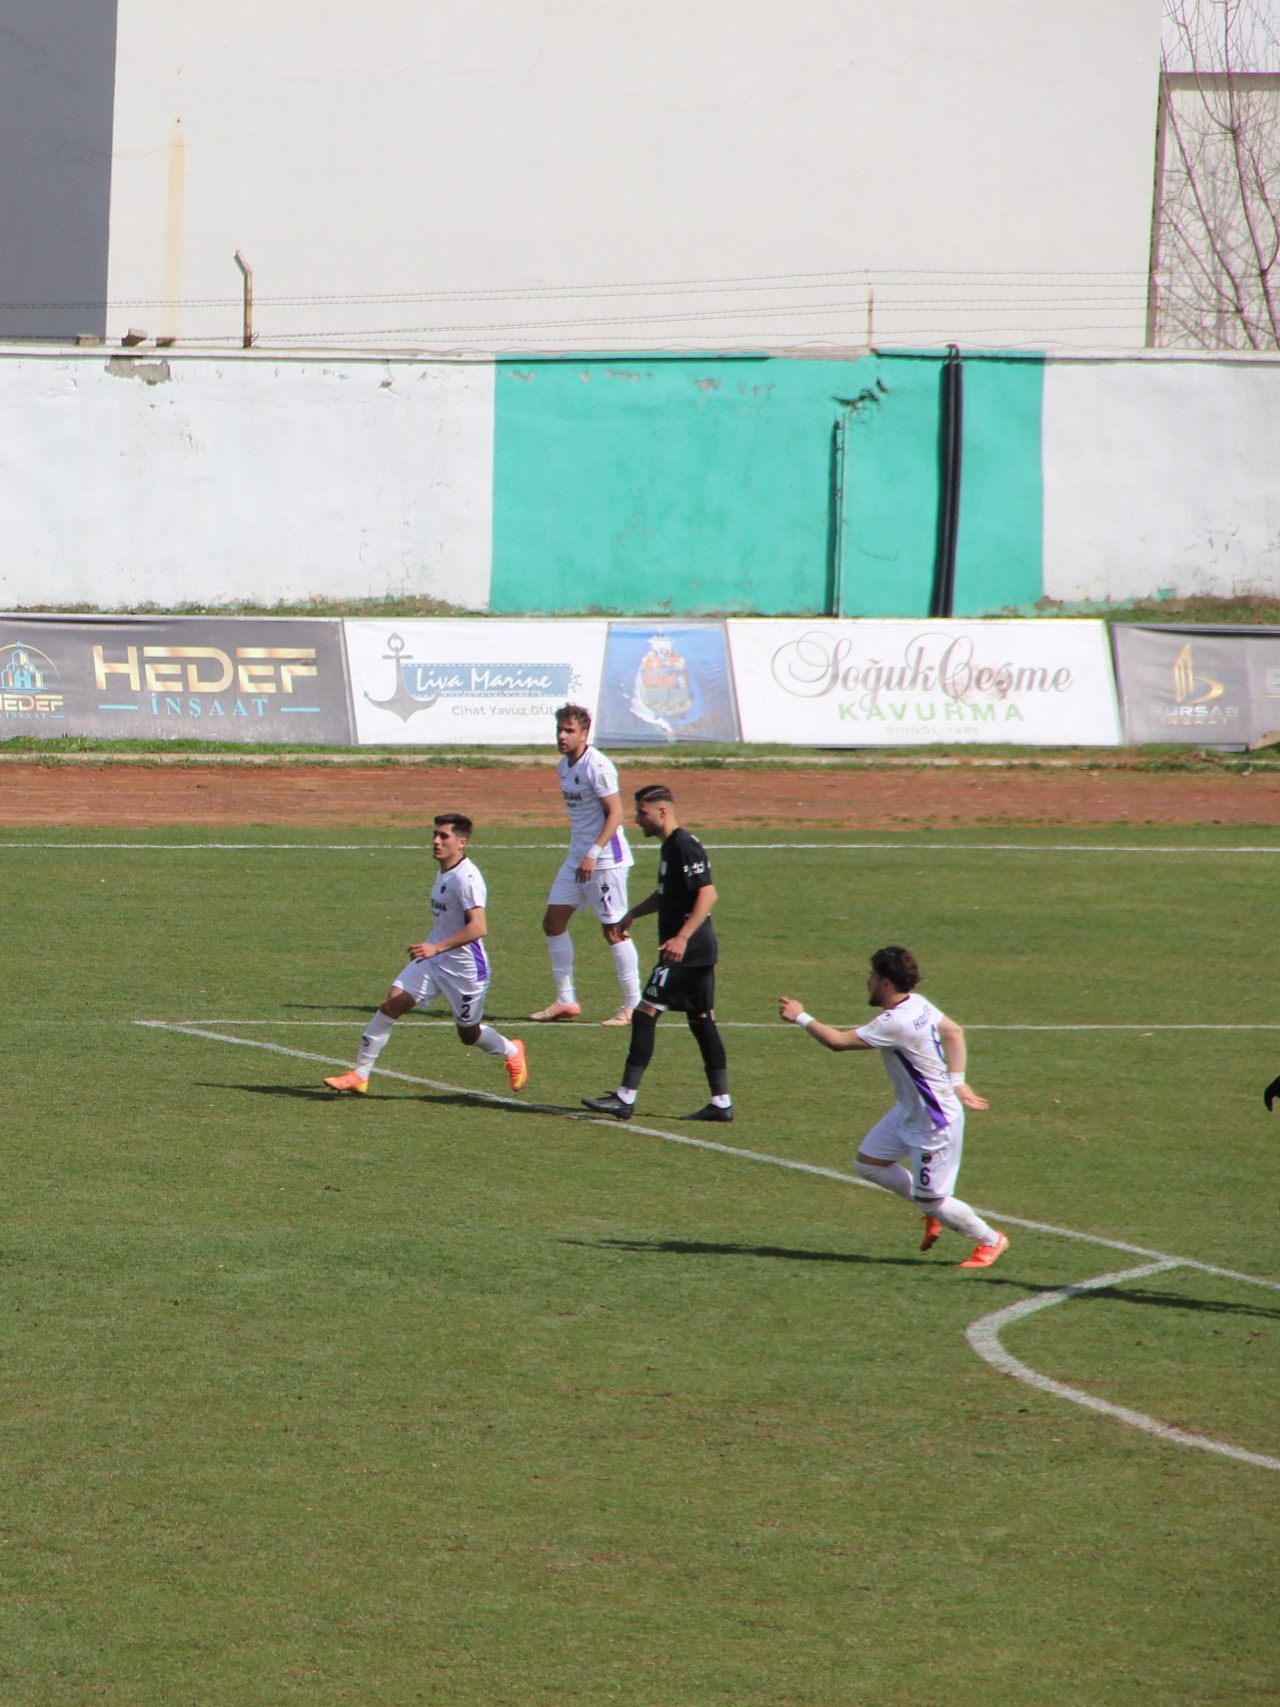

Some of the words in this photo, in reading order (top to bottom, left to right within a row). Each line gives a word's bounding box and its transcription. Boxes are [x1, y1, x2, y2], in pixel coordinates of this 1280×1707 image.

[92, 644, 318, 694] HEDEF
[416, 667, 464, 692] Liva
[470, 667, 553, 690] Marine
[771, 630, 940, 712] Soğuk
[906, 632, 1073, 706] Çeşme
[150, 692, 268, 718] İNŞAAT
[451, 704, 486, 716] Cihat
[488, 705, 528, 716] Yavuz
[837, 702, 1025, 722] KAVURMA
[460, 1004, 471, 1019] 2
[920, 1166, 931, 1186] 6
